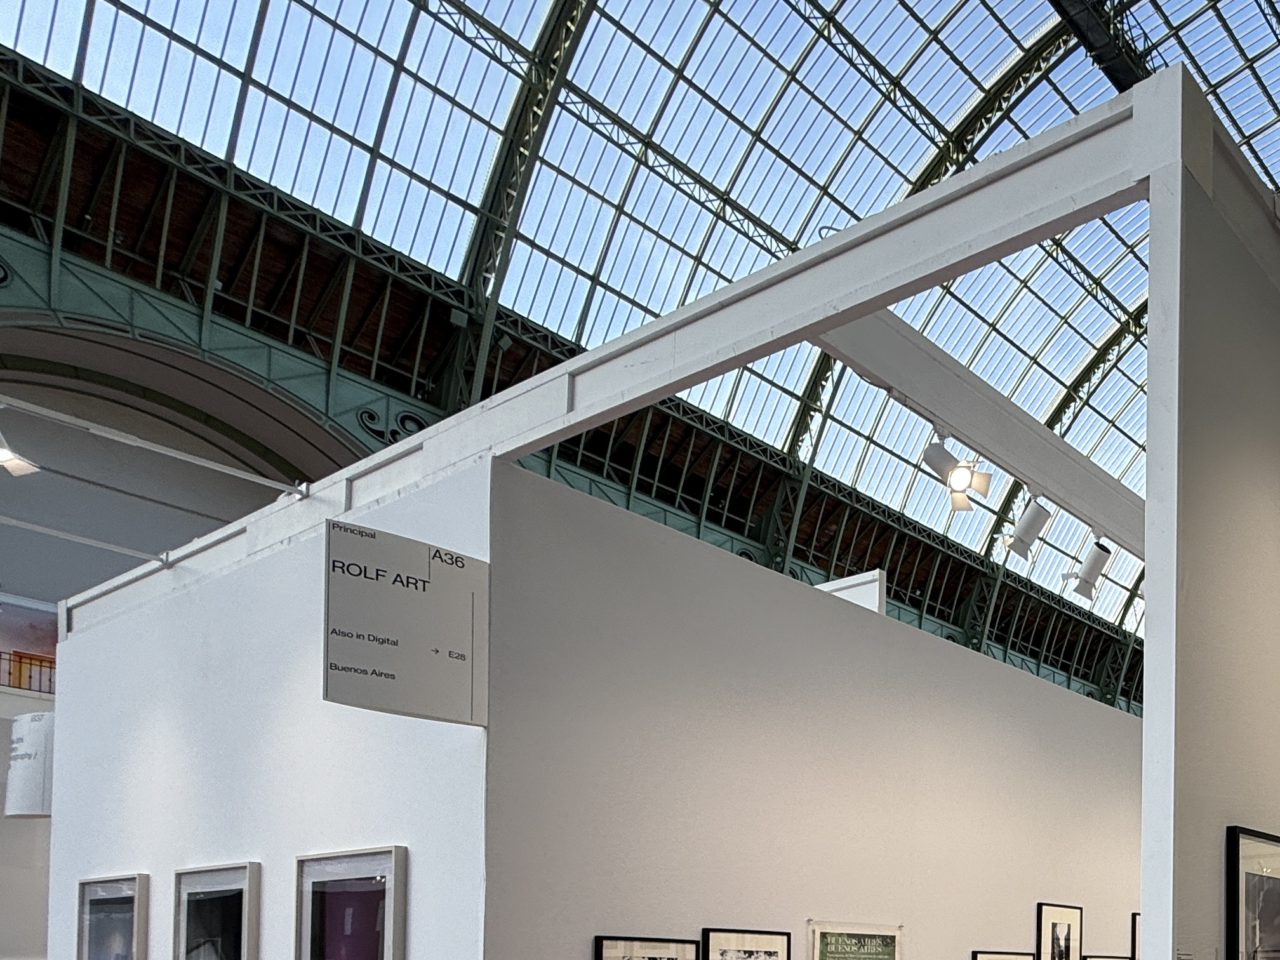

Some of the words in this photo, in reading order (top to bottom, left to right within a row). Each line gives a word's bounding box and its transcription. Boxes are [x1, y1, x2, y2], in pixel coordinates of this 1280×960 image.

[332, 522, 376, 539] Principal
[431, 549, 465, 569] A36
[332, 559, 387, 581] ROLF
[392, 573, 430, 592] ART
[330, 628, 354, 639] Also
[355, 632, 365, 640] in
[367, 634, 399, 647] Digital
[329, 662, 369, 675] Buenos
[370, 668, 396, 680] Aires
